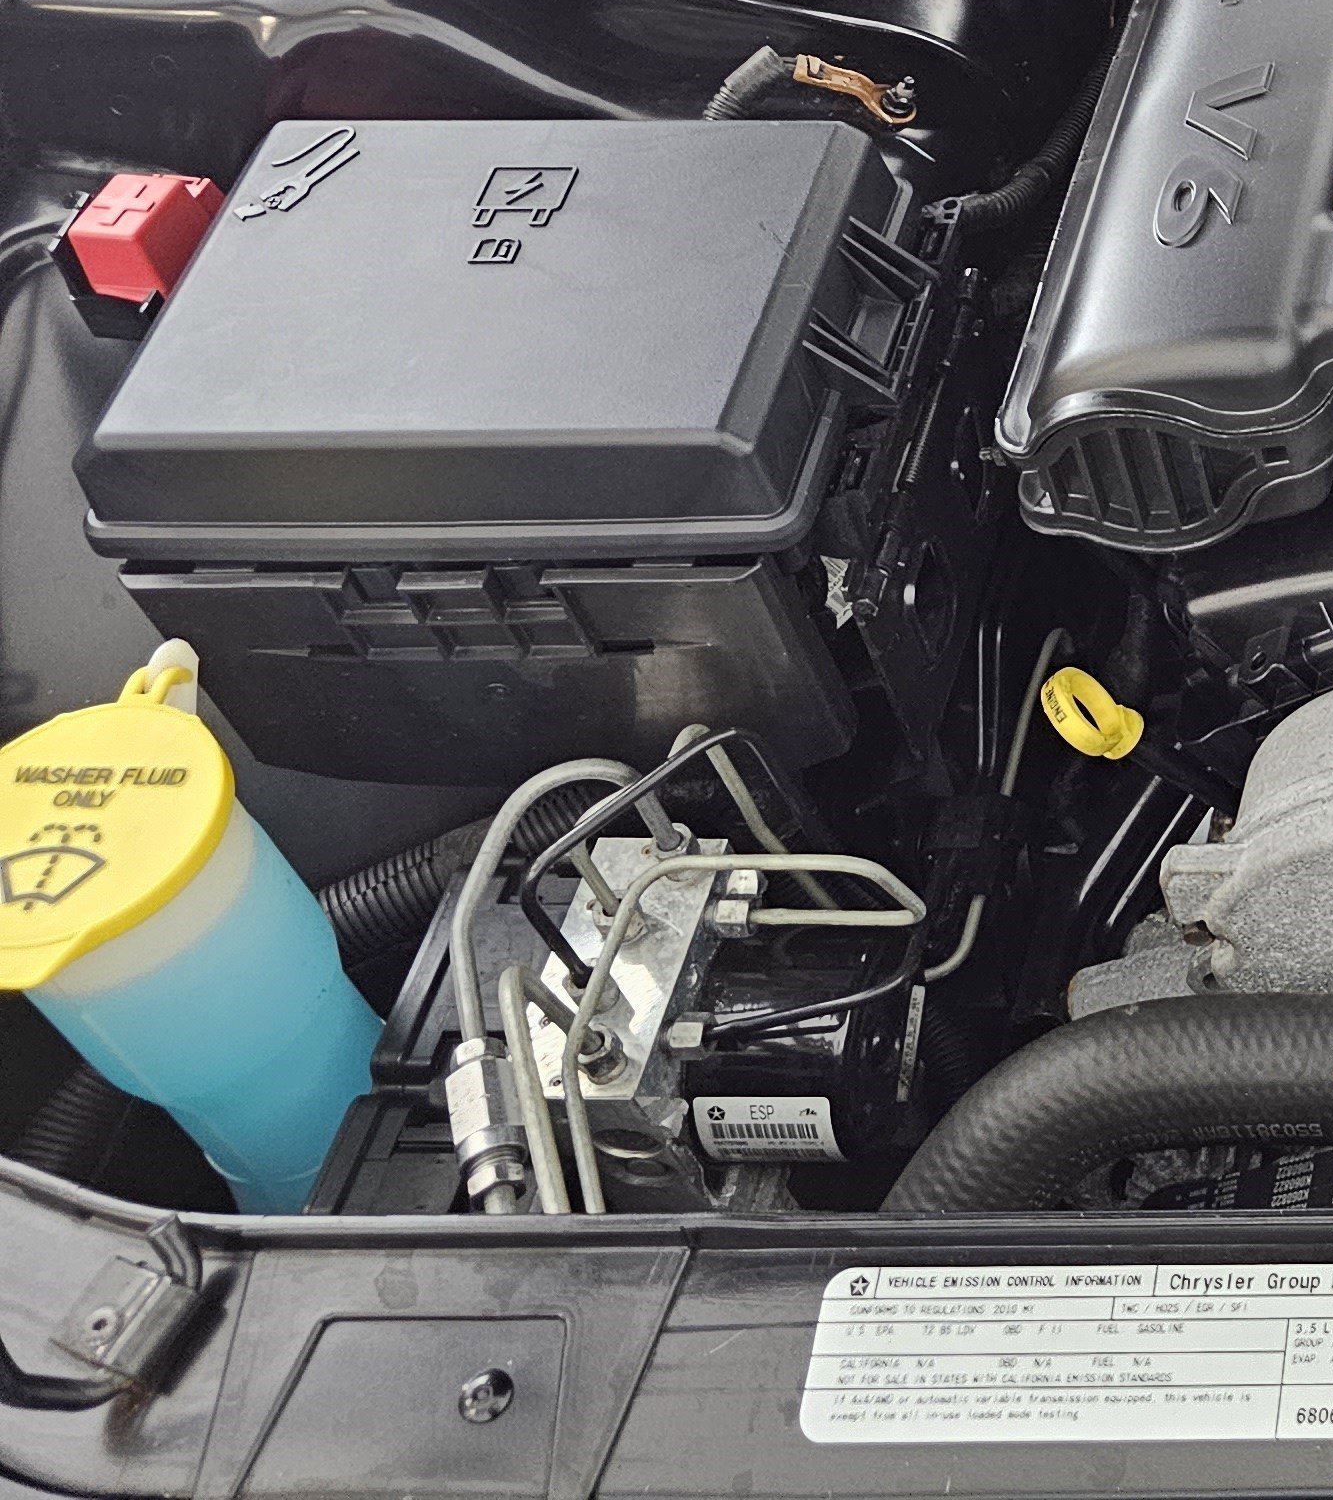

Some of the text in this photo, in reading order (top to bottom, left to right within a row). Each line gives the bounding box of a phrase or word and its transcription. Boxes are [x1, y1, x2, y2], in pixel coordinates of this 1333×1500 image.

[1153, 60, 1276, 248] V6
[15, 766, 189, 787] WASHER FLUID
[52, 789, 117, 808] ONLY
[750, 1105, 775, 1120] ESP
[888, 1275, 1142, 1288] VEHICLE EMISSION CONTROL INFORMATION
[1169, 1273, 1255, 1294] Chrysler
[1267, 1273, 1322, 1293] Group
[920, 1304, 985, 1315] REGULATIONS
[1097, 1324, 1120, 1334] FUEL
[1137, 1323, 1184, 1334] GASOLINE
[1296, 1323, 1330, 1334] 3.5 L
[1294, 1337, 1324, 1348] GROUP
[1292, 1353, 1316, 1364] EVAP
[1002, 1372, 1062, 1383] CALIFORNIA
[1066, 1372, 1116, 1383] EMISSION
